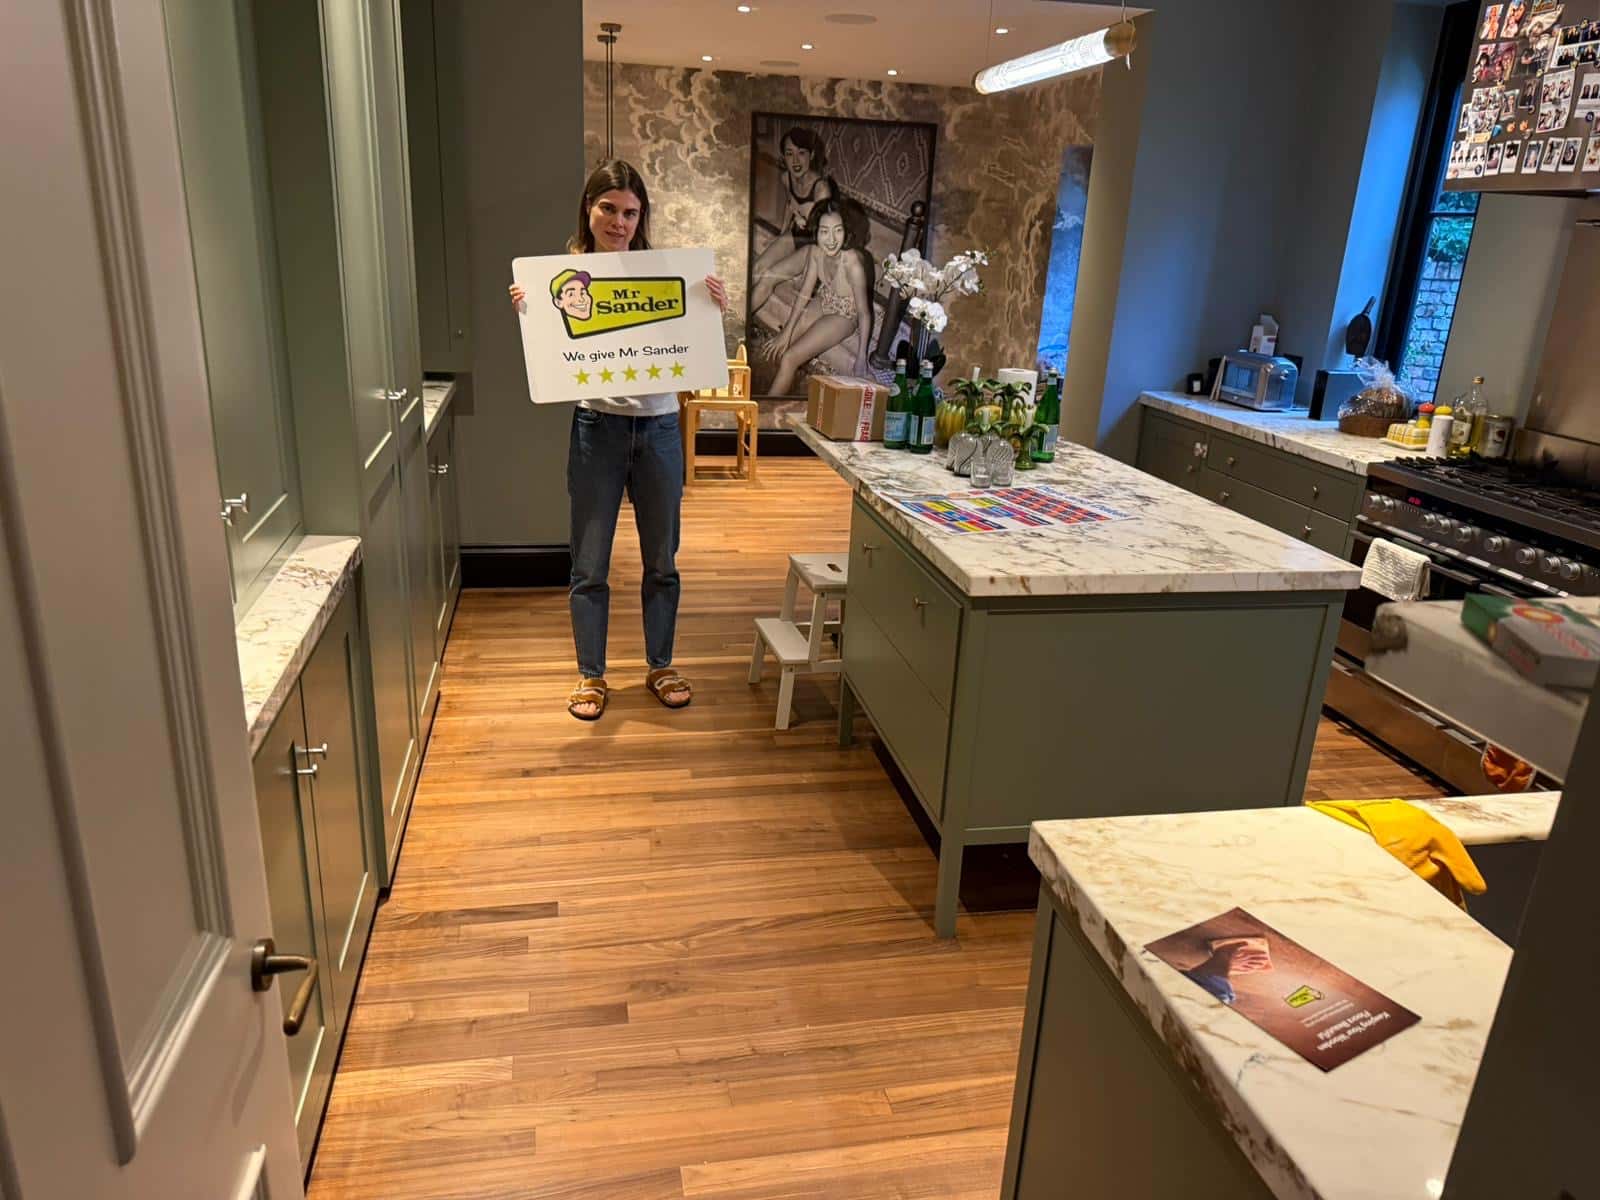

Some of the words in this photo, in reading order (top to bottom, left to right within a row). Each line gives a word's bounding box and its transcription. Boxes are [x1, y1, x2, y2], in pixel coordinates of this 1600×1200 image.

[612, 289, 640, 300] Mr
[596, 296, 679, 315] Sander
[563, 351, 585, 362] We
[589, 350, 615, 363] give
[619, 347, 639, 358] Mr
[643, 344, 689, 356] Sander
